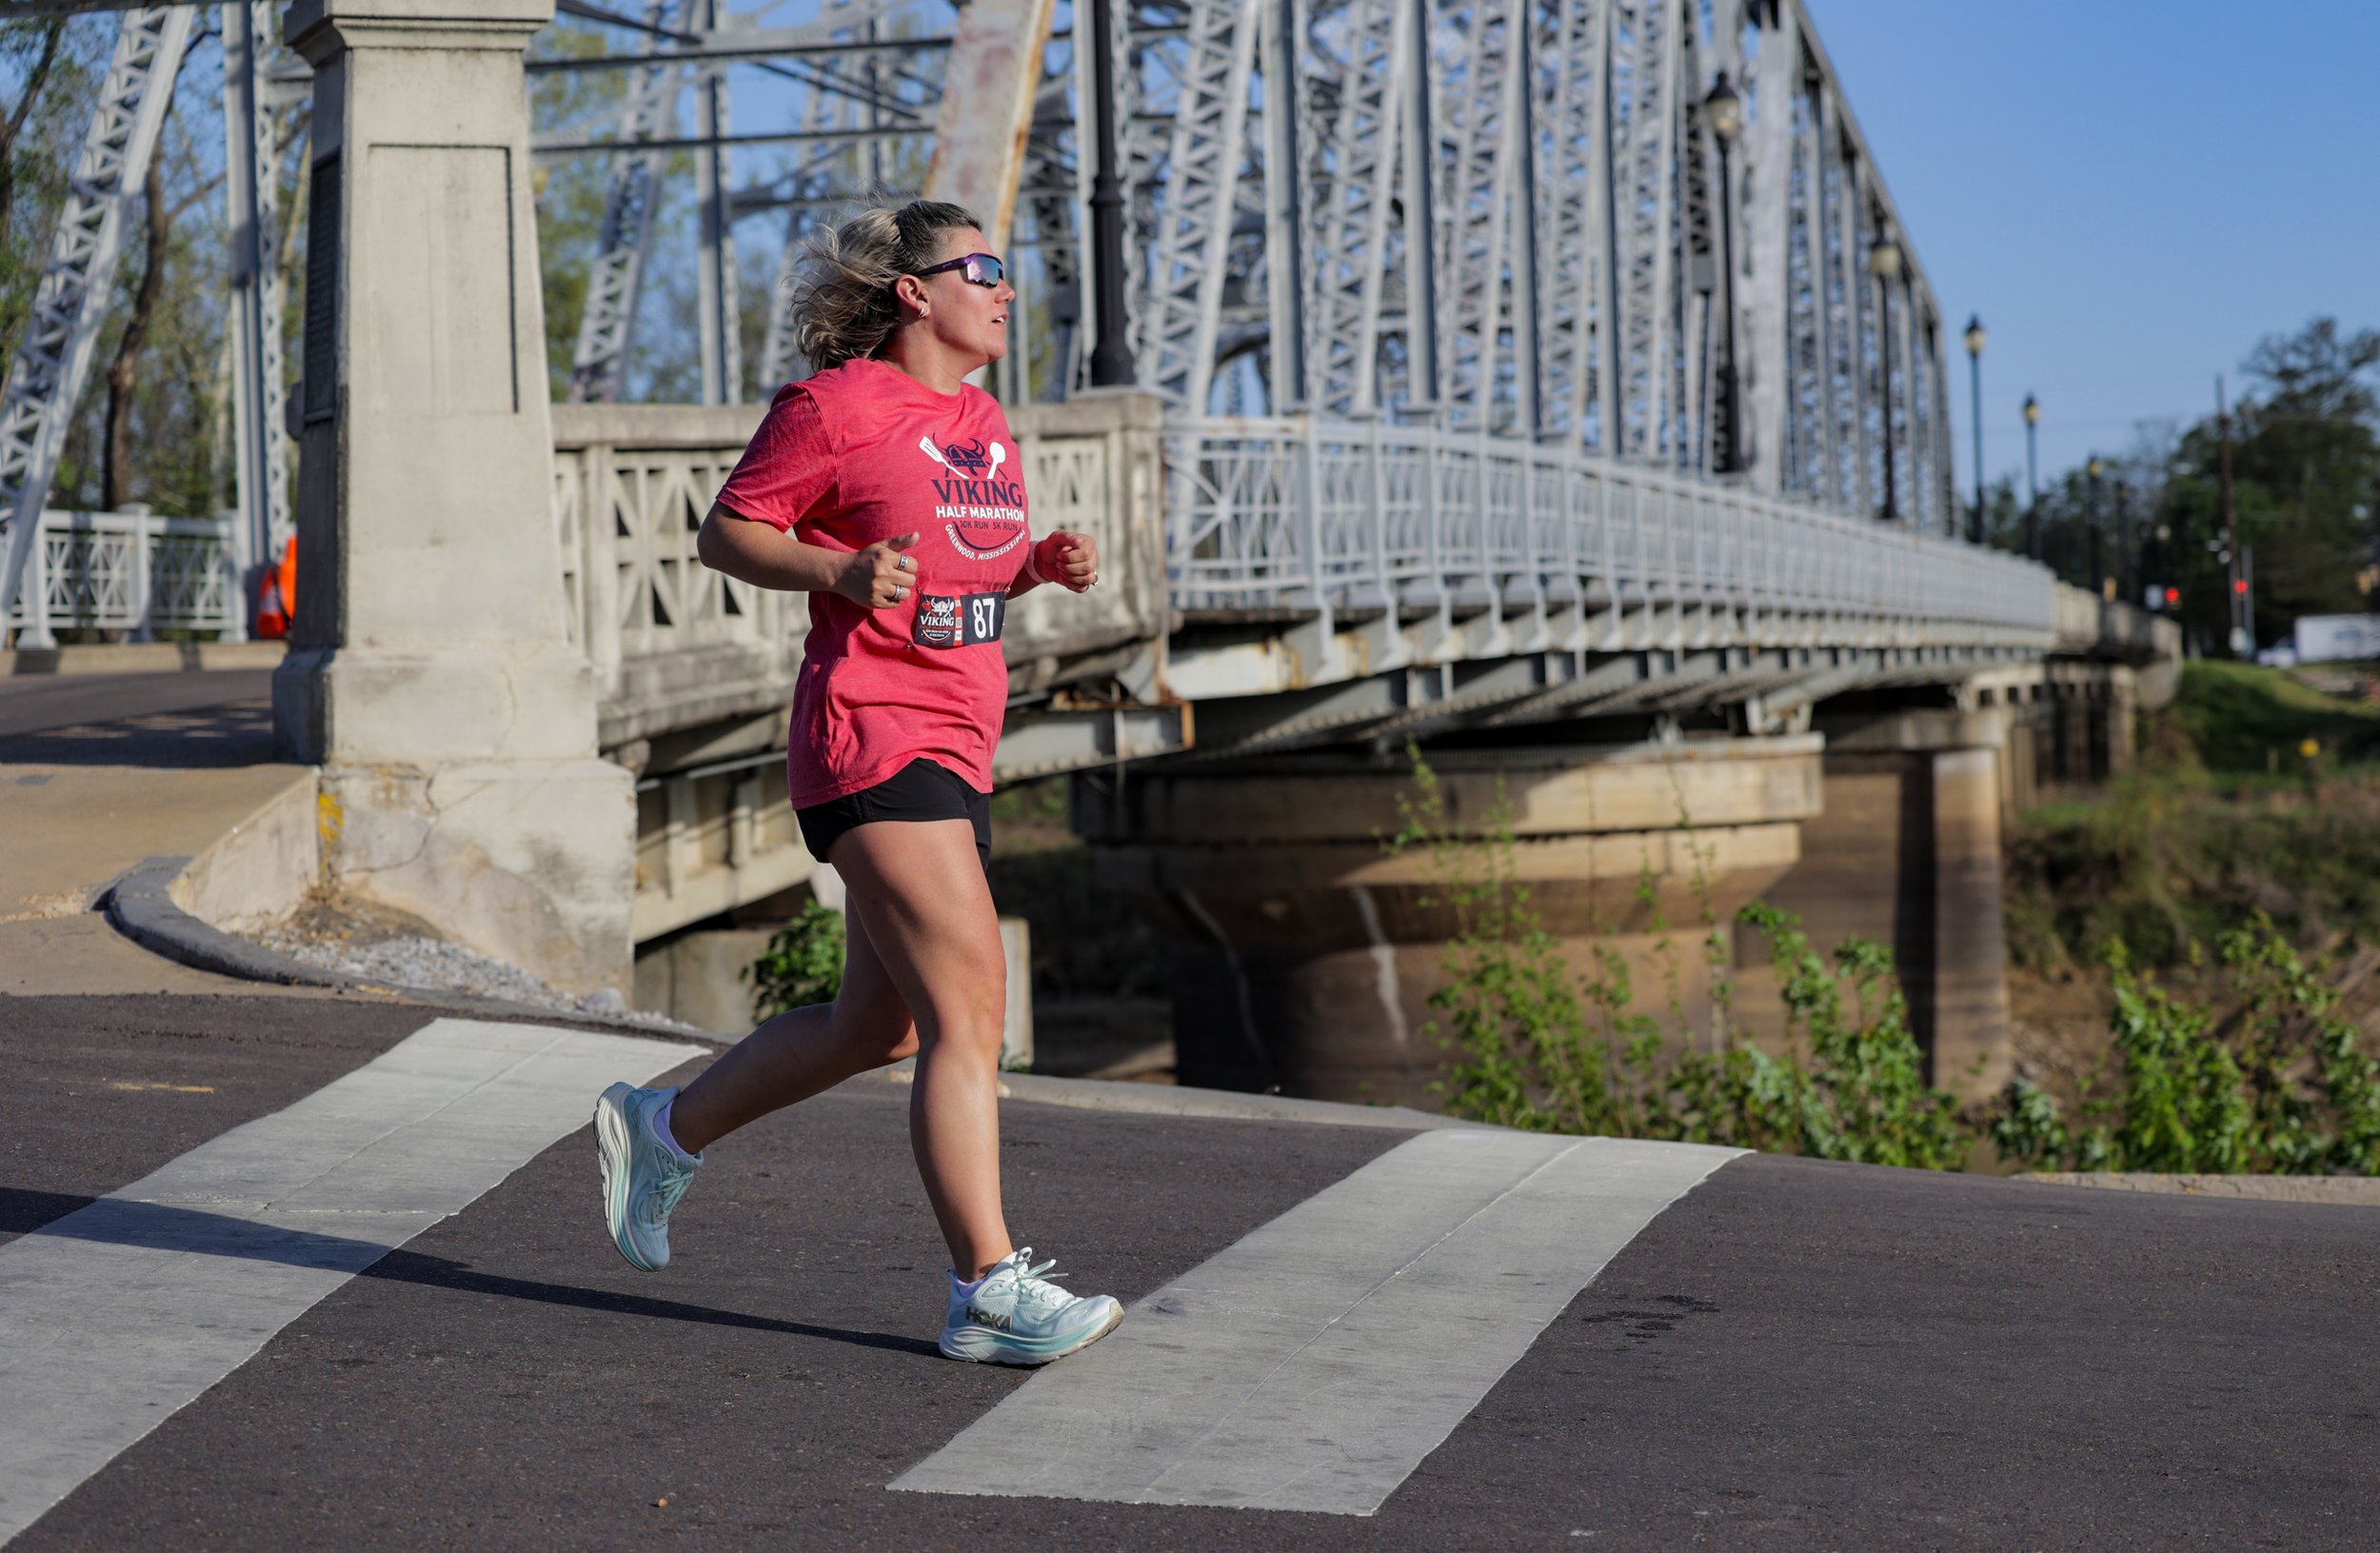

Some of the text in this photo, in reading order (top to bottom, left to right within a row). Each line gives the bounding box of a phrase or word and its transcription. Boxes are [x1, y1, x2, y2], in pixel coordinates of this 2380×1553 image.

[931, 479, 1022, 508] VIKING
[936, 506, 1024, 523] HALF MARATHON
[960, 520, 972, 528] 10K
[974, 521, 988, 529] RUN
[945, 524, 1025, 561] GREENWOOD, MISSISSIPPI
[920, 615, 955, 627] VIKING
[972, 597, 996, 639] 87
[965, 1304, 1012, 1333] HOKA
